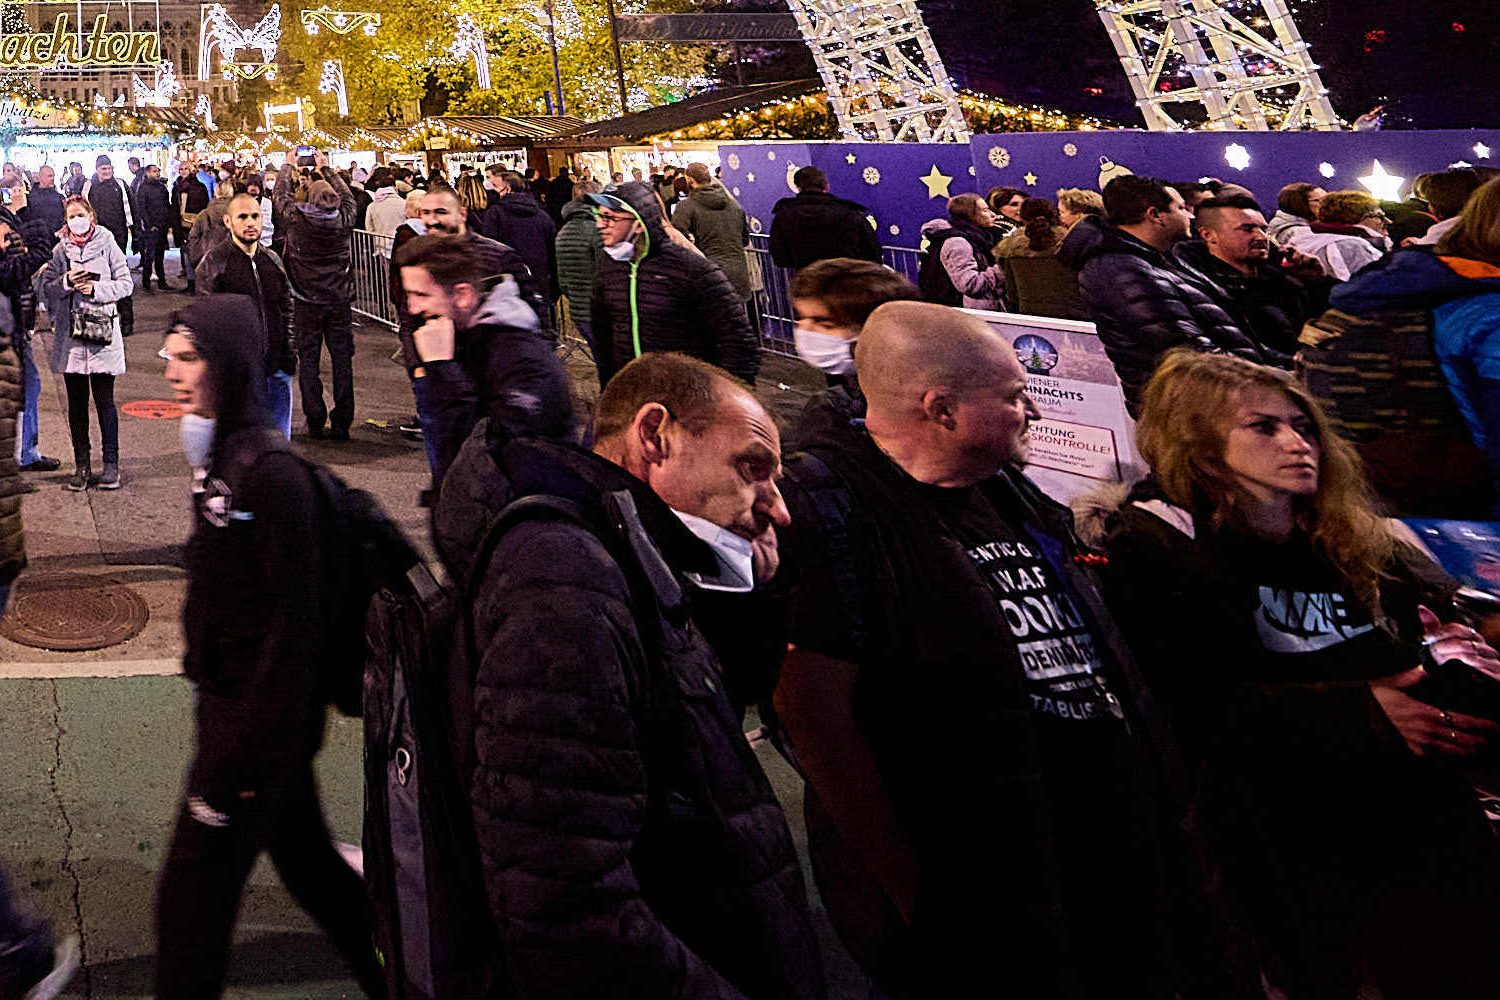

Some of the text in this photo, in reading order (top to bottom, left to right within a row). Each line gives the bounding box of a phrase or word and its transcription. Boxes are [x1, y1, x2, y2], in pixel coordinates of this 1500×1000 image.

[1025, 385, 1084, 401] HNACHTS
[1030, 394, 1062, 407] RAUM
[1028, 423, 1075, 439] CHTUNG
[1028, 432, 1111, 455] SKONTROLLE!
